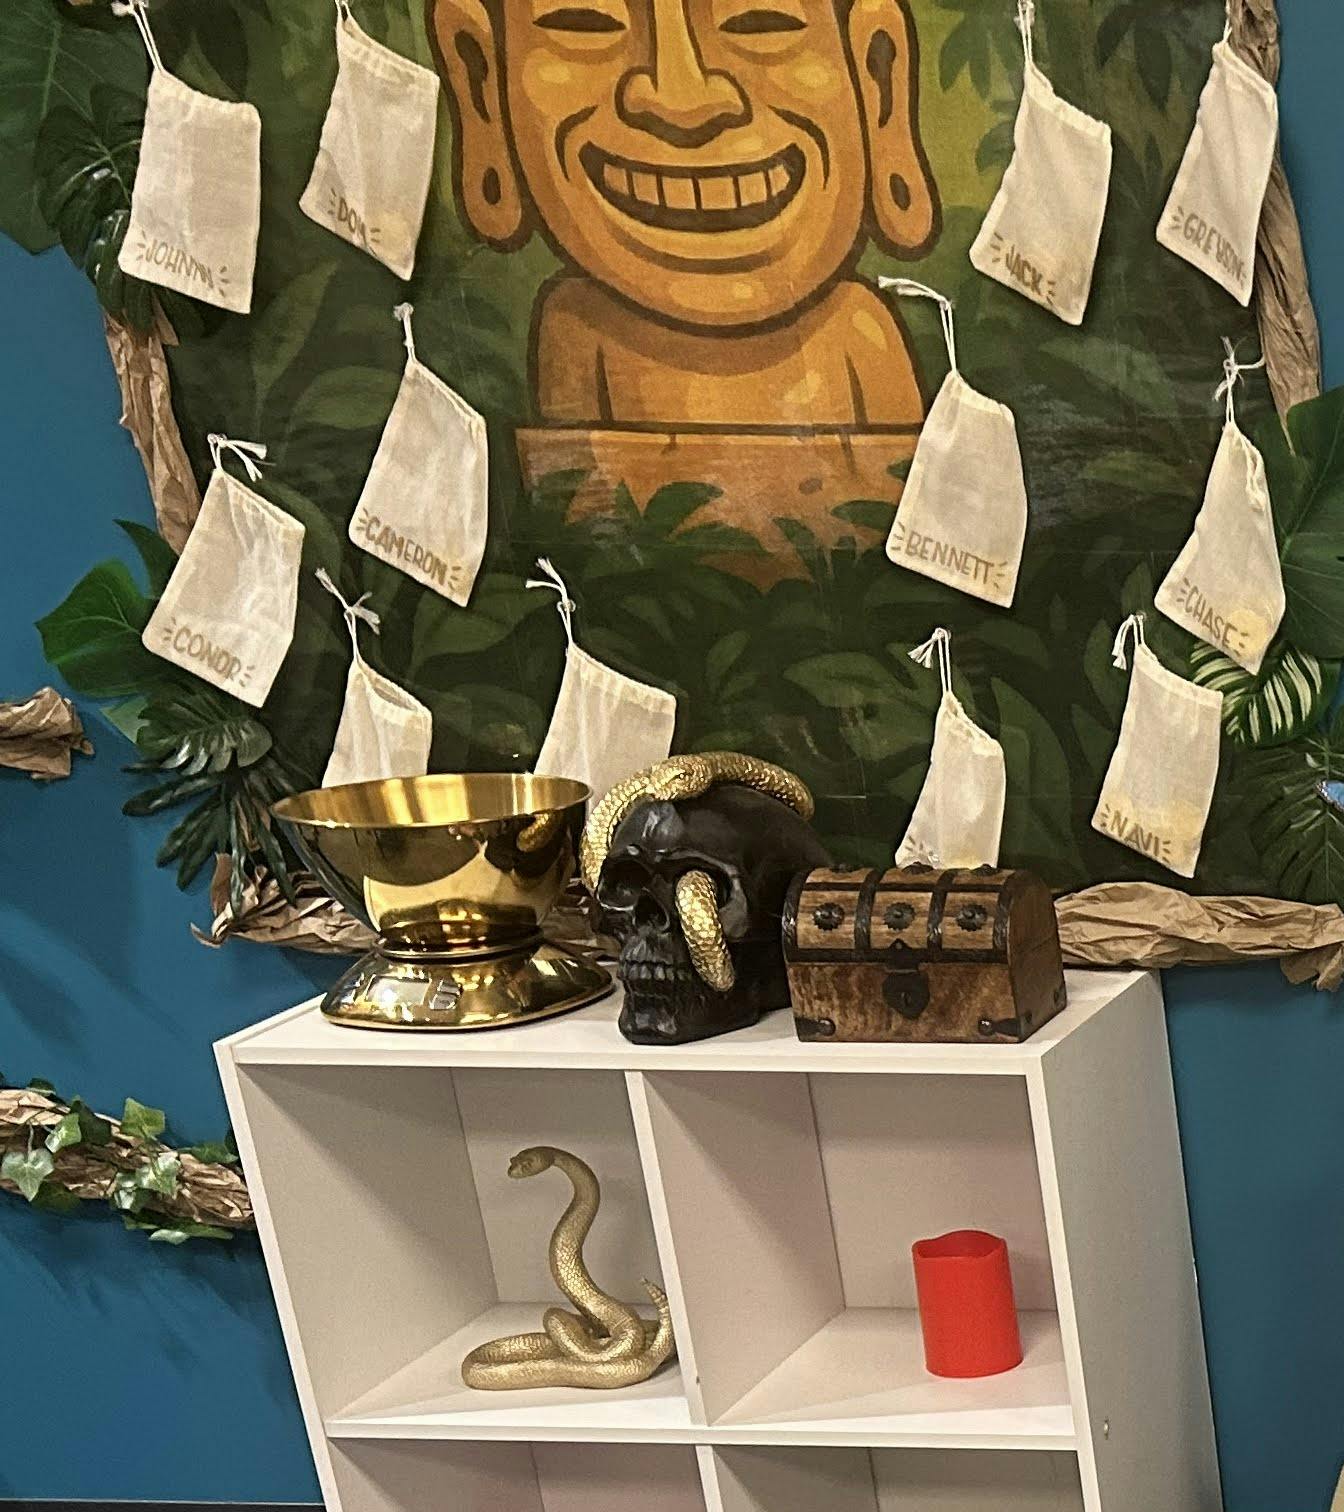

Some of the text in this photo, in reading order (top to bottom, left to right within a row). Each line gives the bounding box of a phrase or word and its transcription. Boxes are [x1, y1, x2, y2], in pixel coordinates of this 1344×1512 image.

[1005, 244, 1044, 297] JACK
[365, 516, 448, 586] CAMERON
[905, 531, 995, 586] BENNETT
[1184, 585, 1240, 650] CHASE
